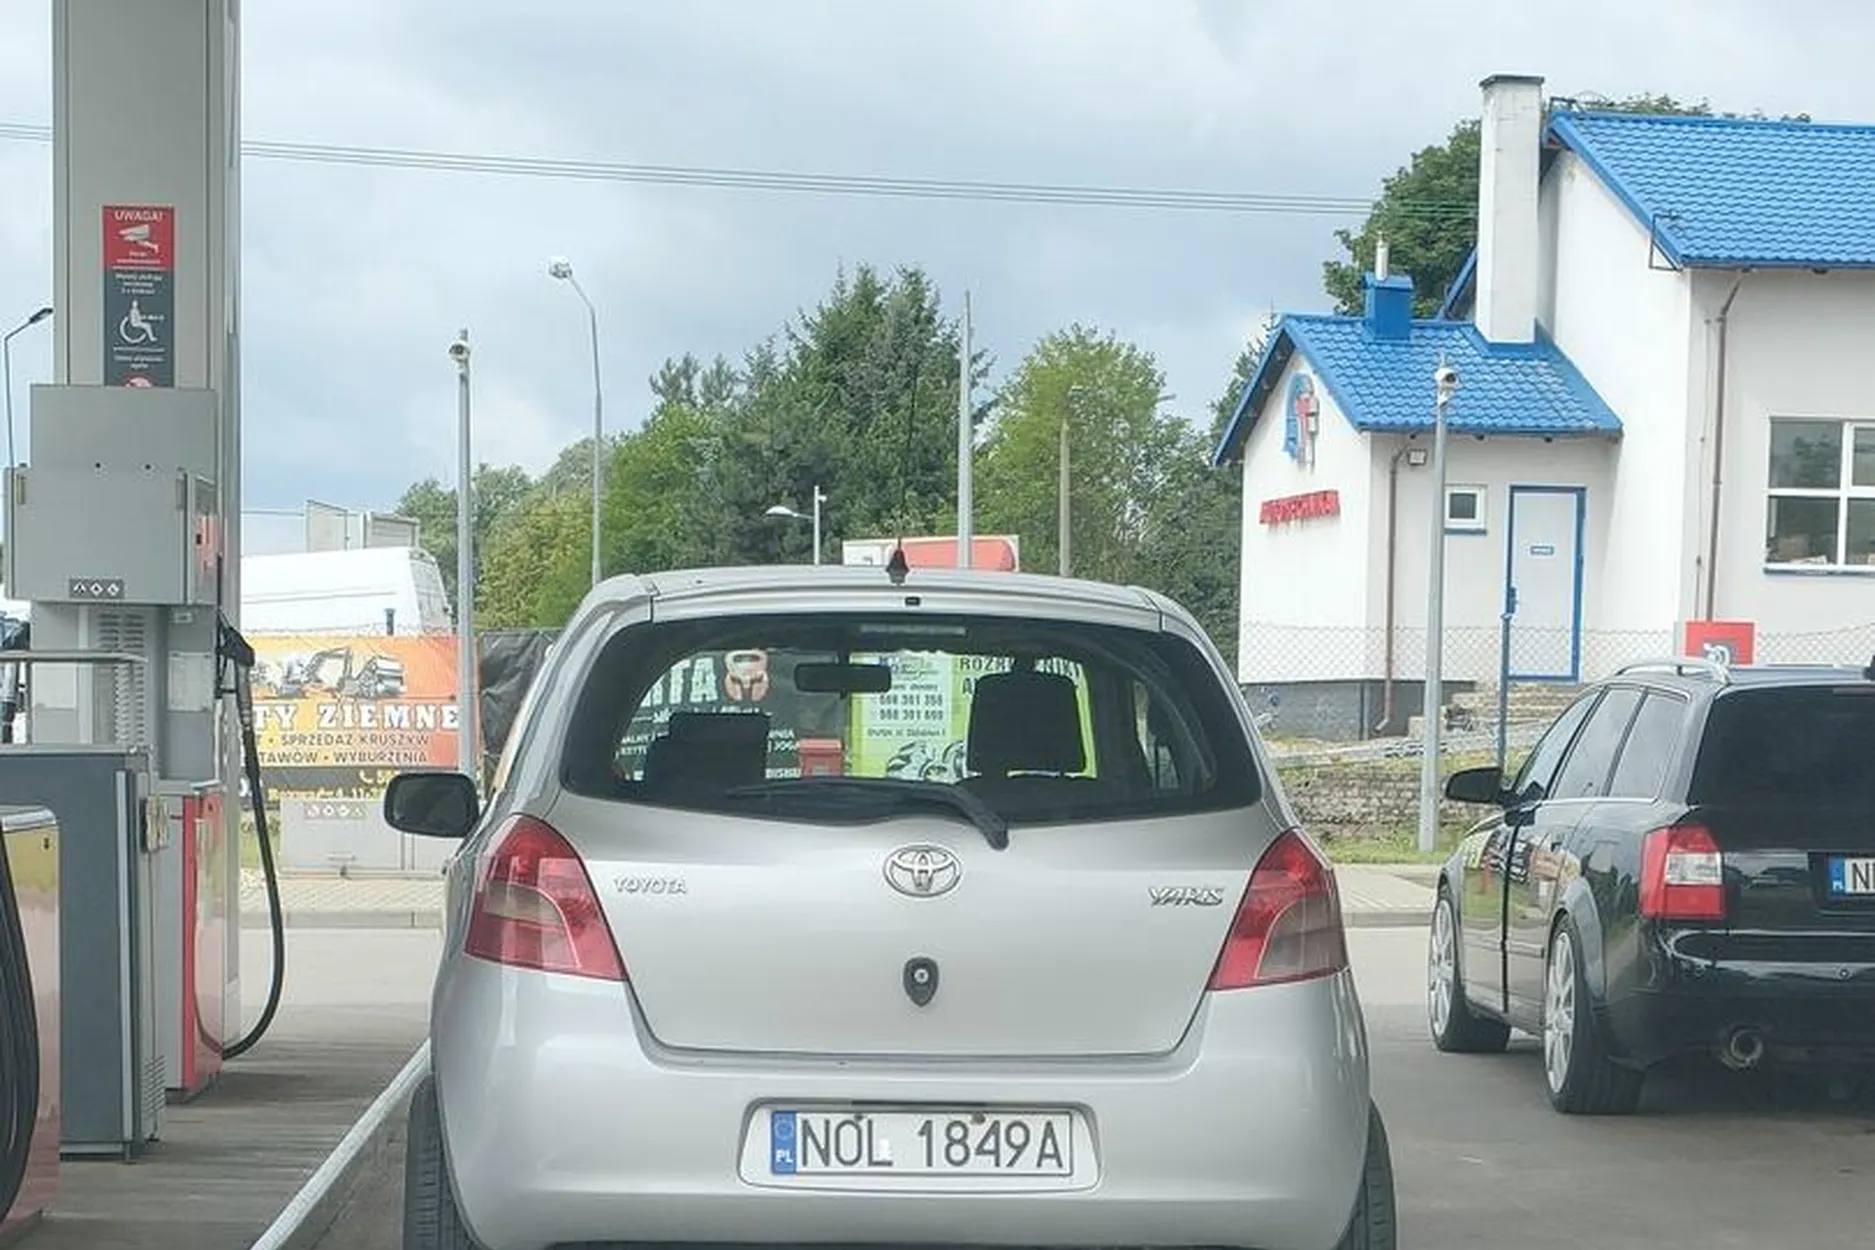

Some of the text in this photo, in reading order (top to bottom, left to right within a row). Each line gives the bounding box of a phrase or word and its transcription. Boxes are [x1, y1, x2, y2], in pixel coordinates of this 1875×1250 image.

[319, 704, 459, 730] ZIEMNE
[613, 877, 687, 894] TOYOTA
[1852, 862, 1875, 890] N
[1147, 886, 1225, 906] YARIS
[801, 1119, 1063, 1168] NOL 1849A
[775, 1150, 794, 1164] PL
